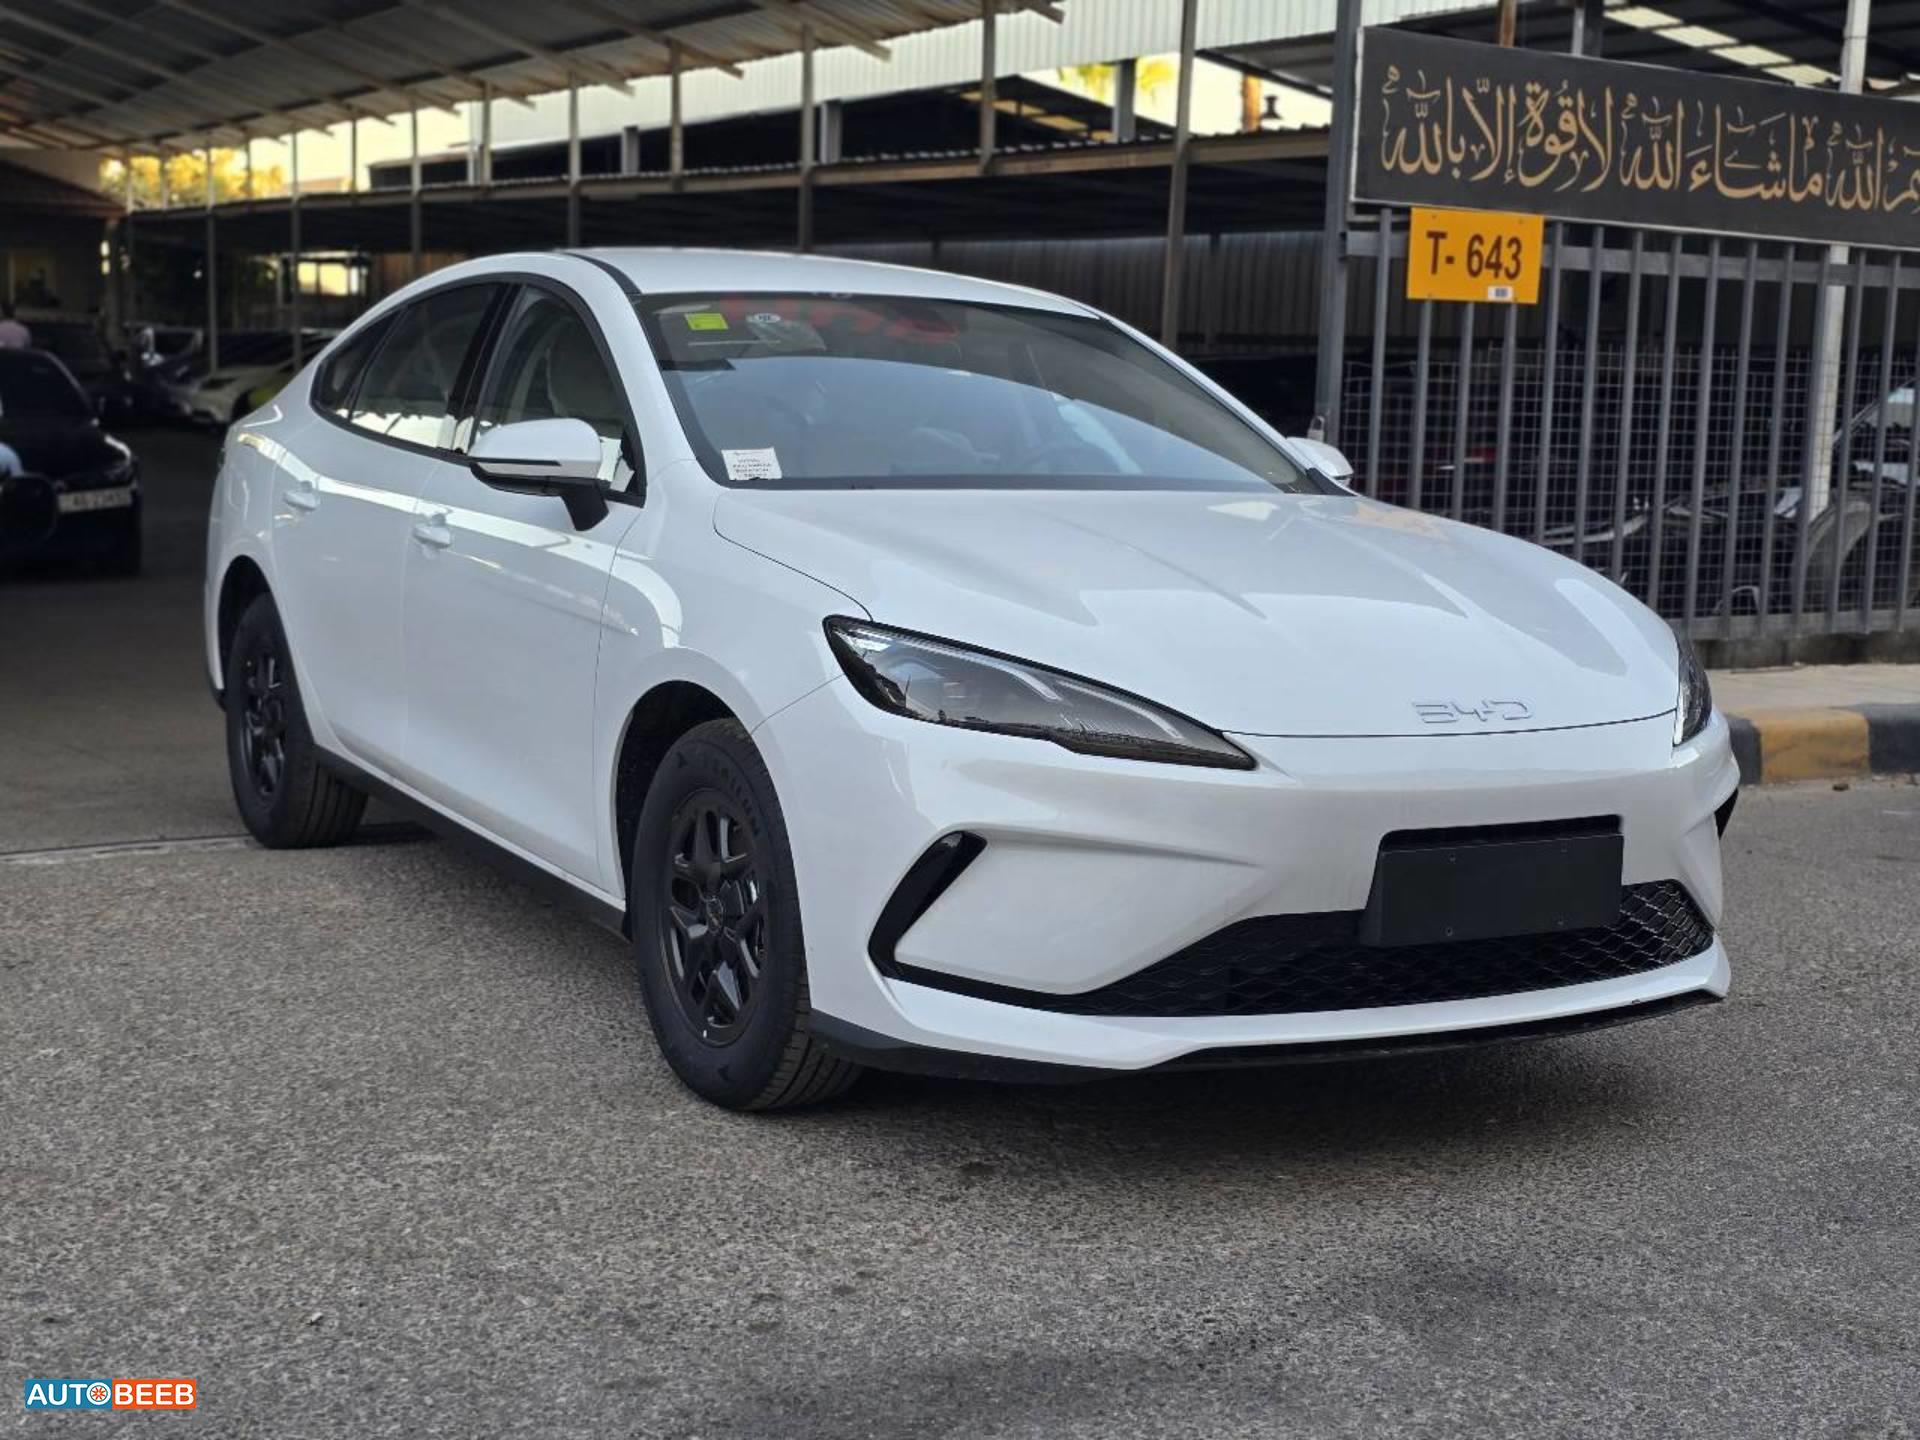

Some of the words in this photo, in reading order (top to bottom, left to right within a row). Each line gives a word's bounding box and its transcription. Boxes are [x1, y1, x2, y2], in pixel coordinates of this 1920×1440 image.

[1426, 230, 1455, 276] T-
[1466, 233, 1523, 280] 643
[1411, 700, 1532, 724] BYD
